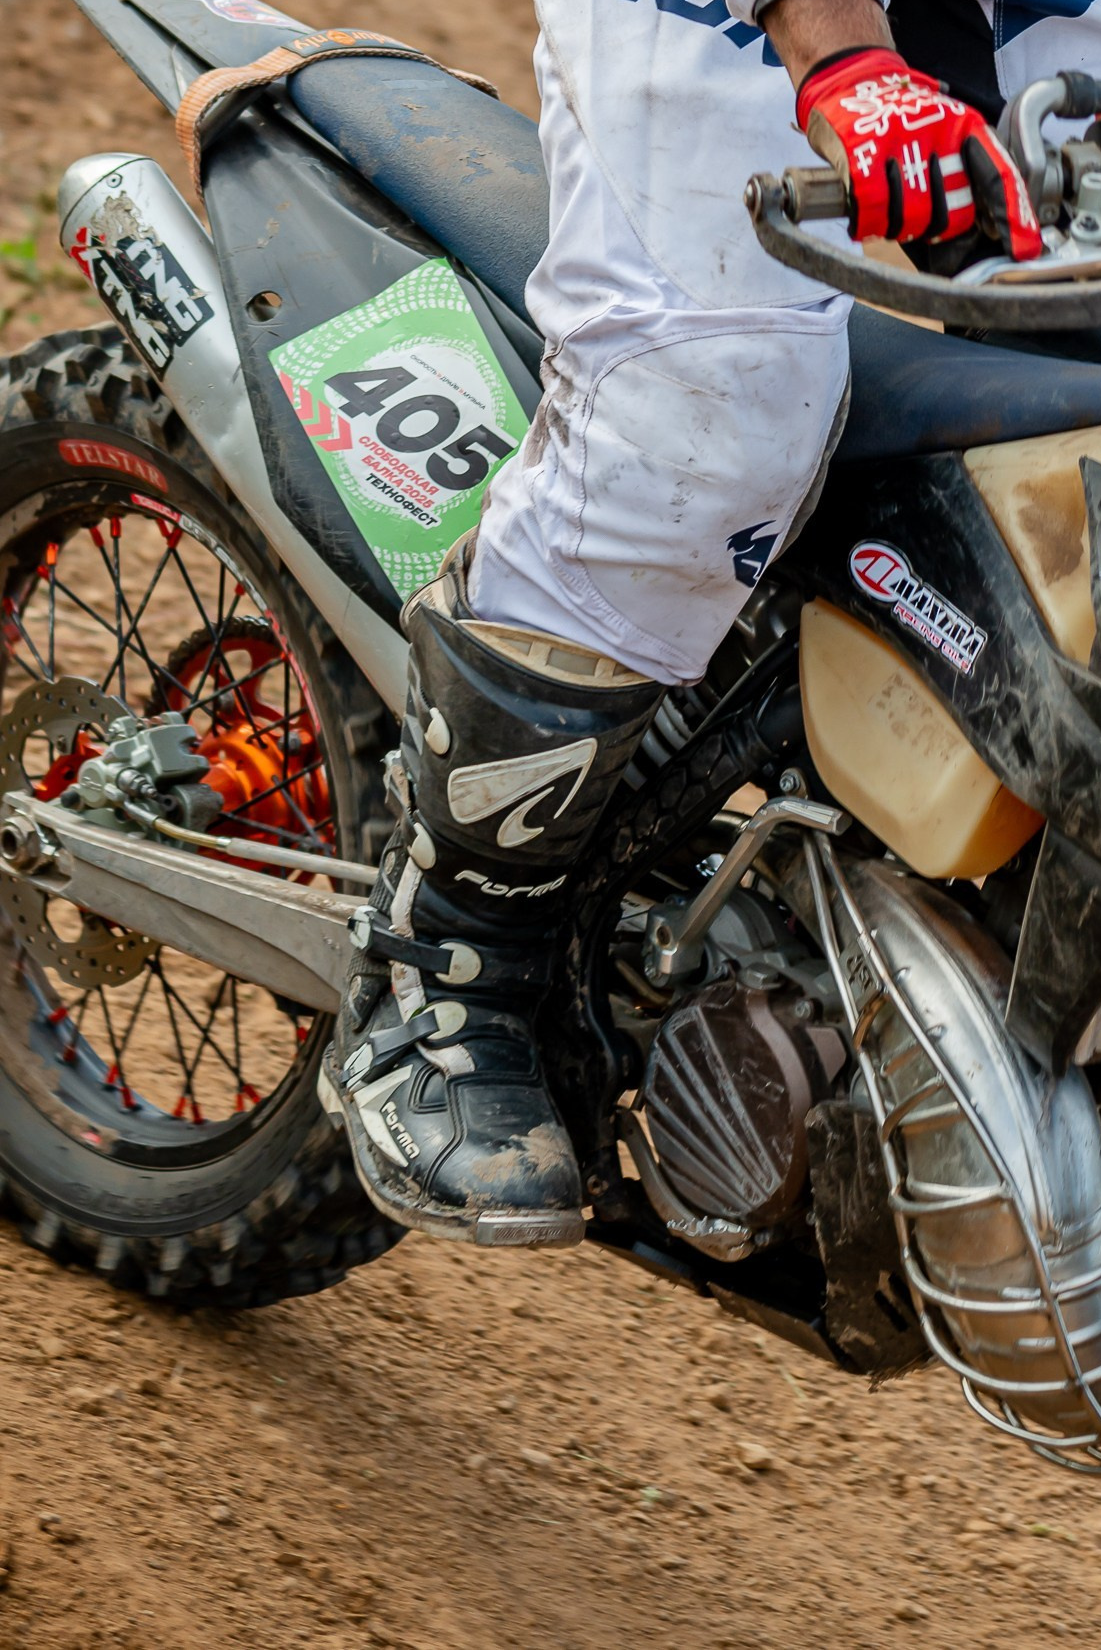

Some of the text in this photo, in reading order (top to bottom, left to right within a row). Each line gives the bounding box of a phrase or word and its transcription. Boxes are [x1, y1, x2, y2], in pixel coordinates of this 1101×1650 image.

[323, 366, 515, 491] 405
[66, 443, 164, 486] TELSTAR
[358, 436, 440, 495] СЛОБОДСКАЯ
[362, 455, 435, 510] БАЛКА 2025
[365, 473, 439, 527] ТЕХНОФЕСТ
